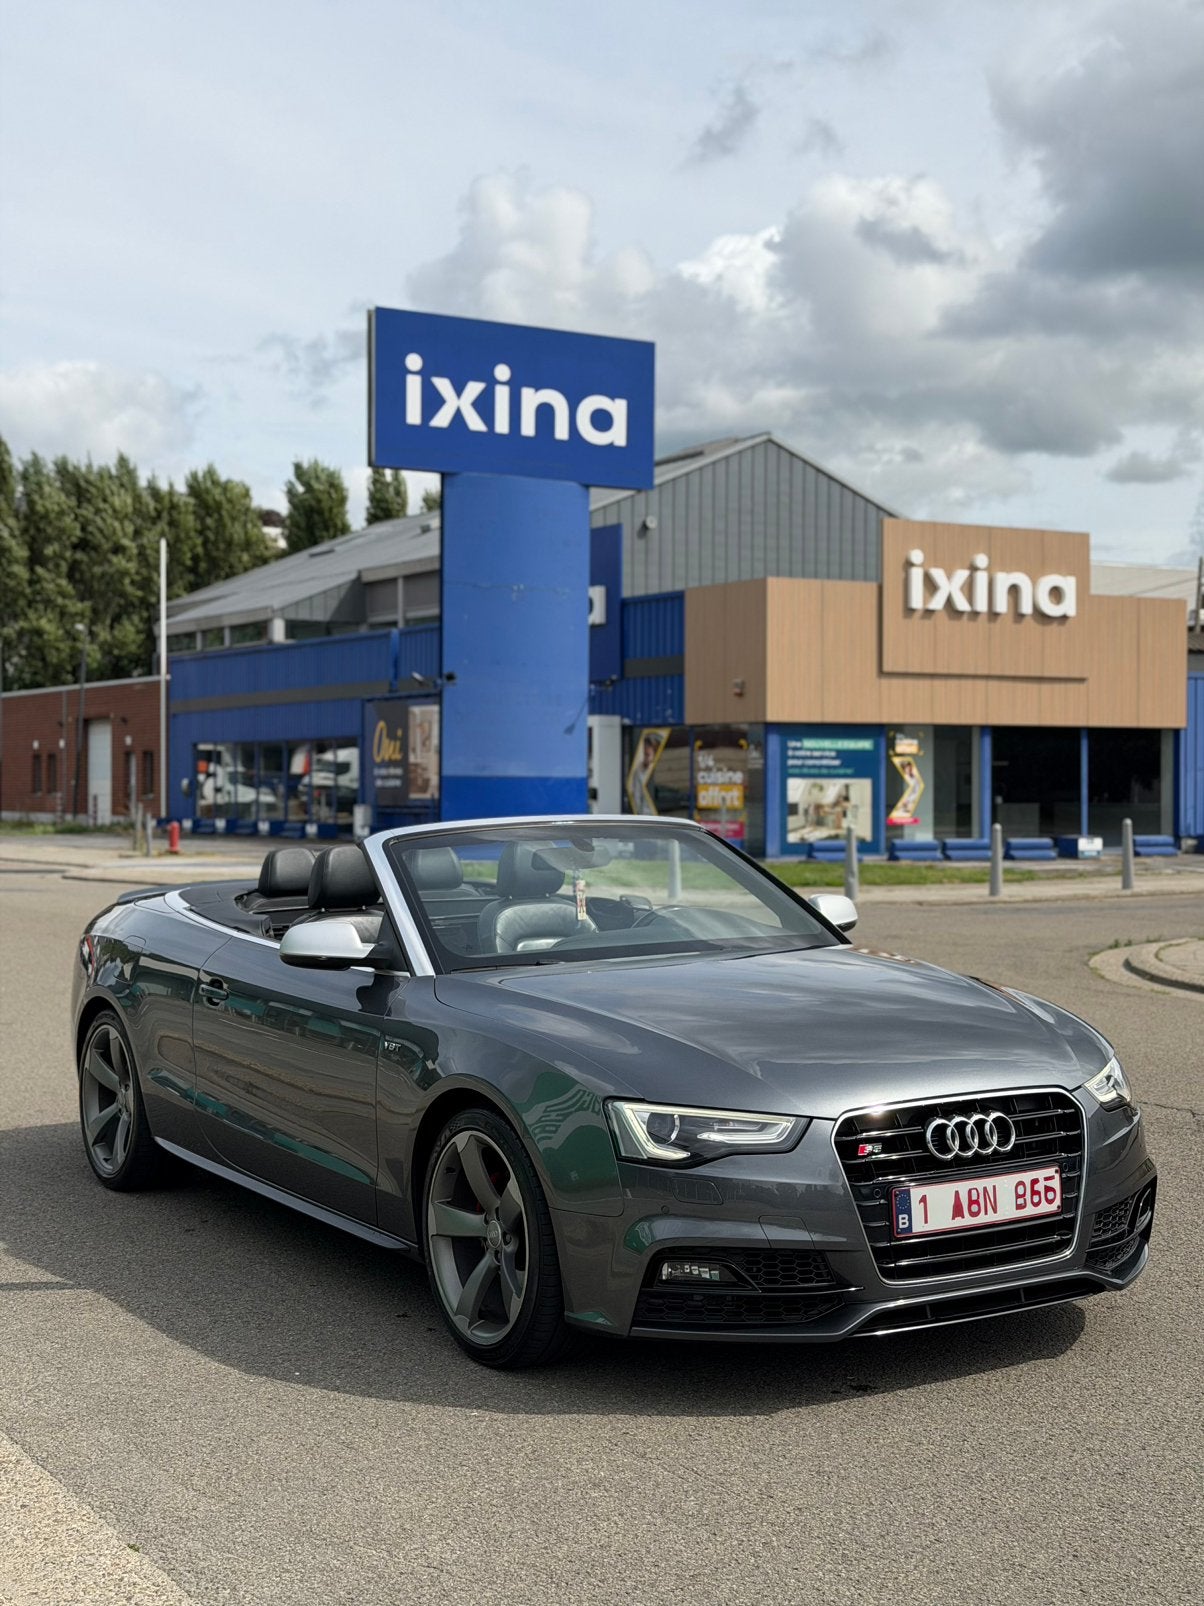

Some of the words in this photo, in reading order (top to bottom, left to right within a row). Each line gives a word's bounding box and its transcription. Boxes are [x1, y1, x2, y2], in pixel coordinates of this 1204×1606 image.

[405, 352, 628, 448] ixina
[907, 548, 1077, 618] ixina
[697, 767, 744, 783] cuisine
[898, 1214, 910, 1229] B
[918, 1194, 929, 1225] 1
